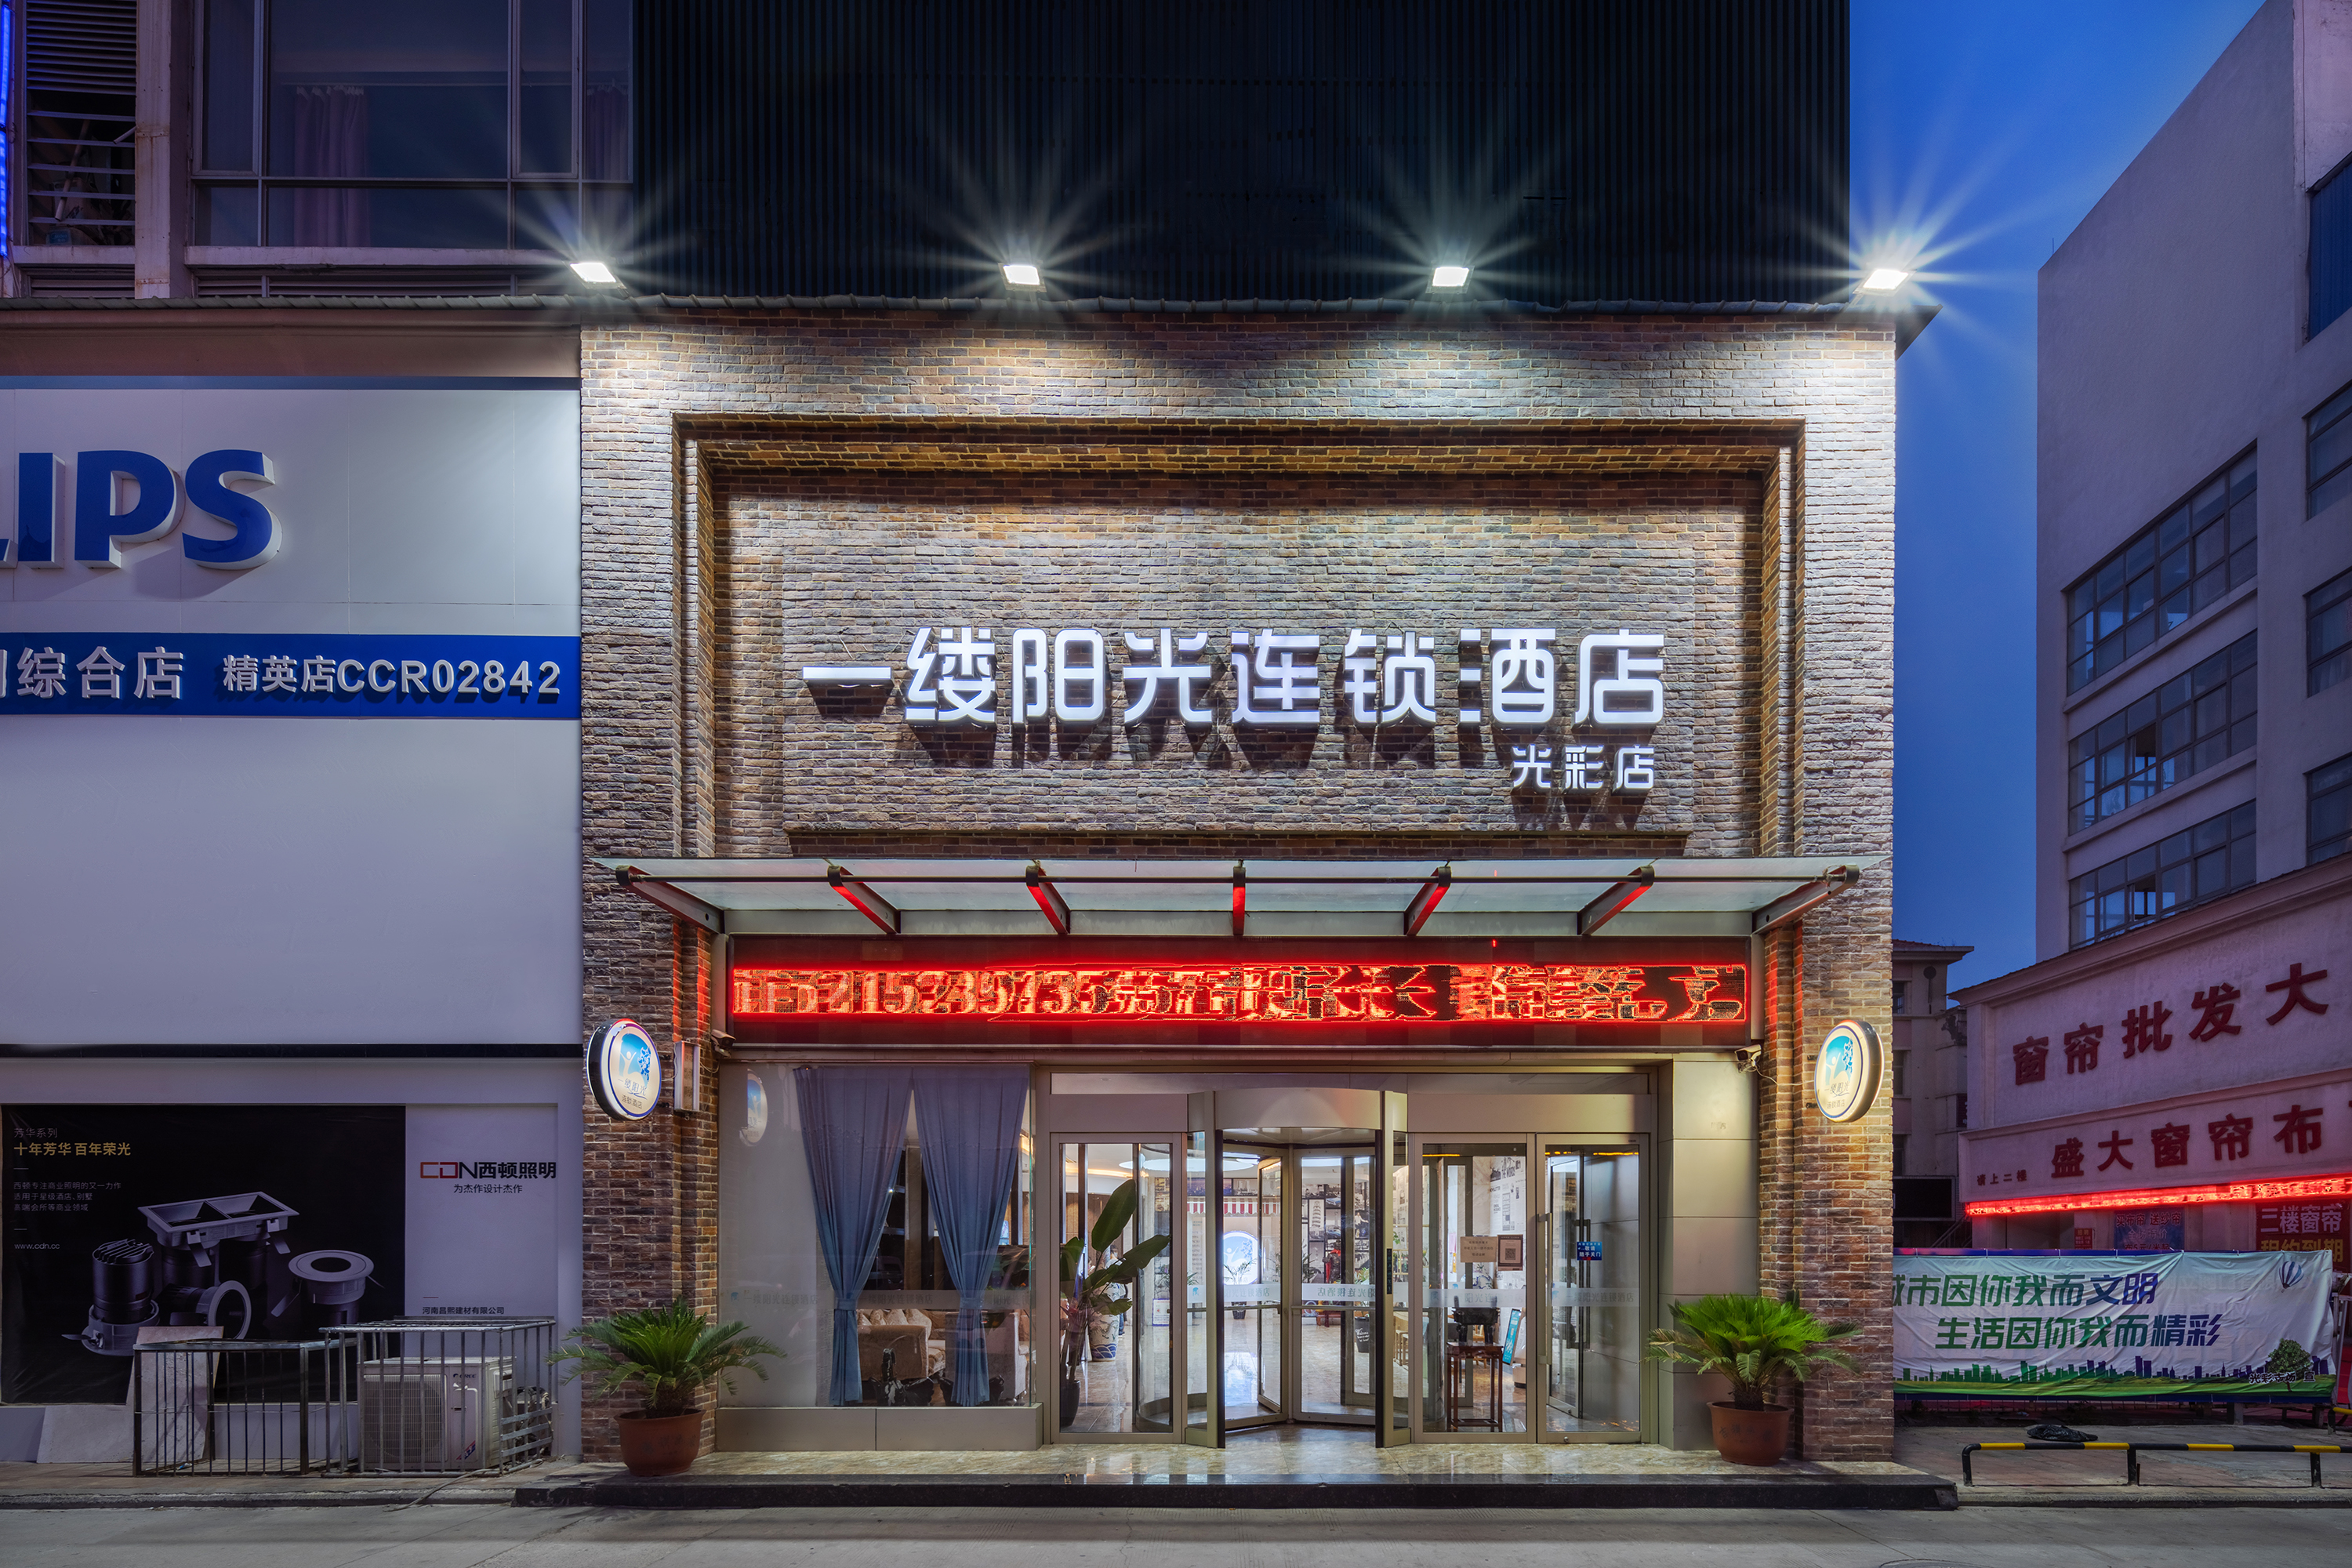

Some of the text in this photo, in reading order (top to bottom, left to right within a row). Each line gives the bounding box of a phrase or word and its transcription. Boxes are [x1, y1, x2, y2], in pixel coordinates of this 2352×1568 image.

[0, 449, 282, 571] IPS
[0, 646, 561, 700] 综合店 精英店CCR02842
[802, 626, 1664, 726] 一缕阳光连锁酒店
[1512, 744, 1655, 789] 光彩店
[2013, 963, 2328, 1086] 窗帘批发大
[13, 1142, 131, 1156] 十年芳华 百年荣光
[14, 1127, 58, 1138] 芳华系列
[2051, 1100, 2352, 1178] 盛大窗帘布
[453, 1184, 523, 1193] 为杰作设计杰作
[1935, 1313, 2223, 1349] 生活因你我而精彩
